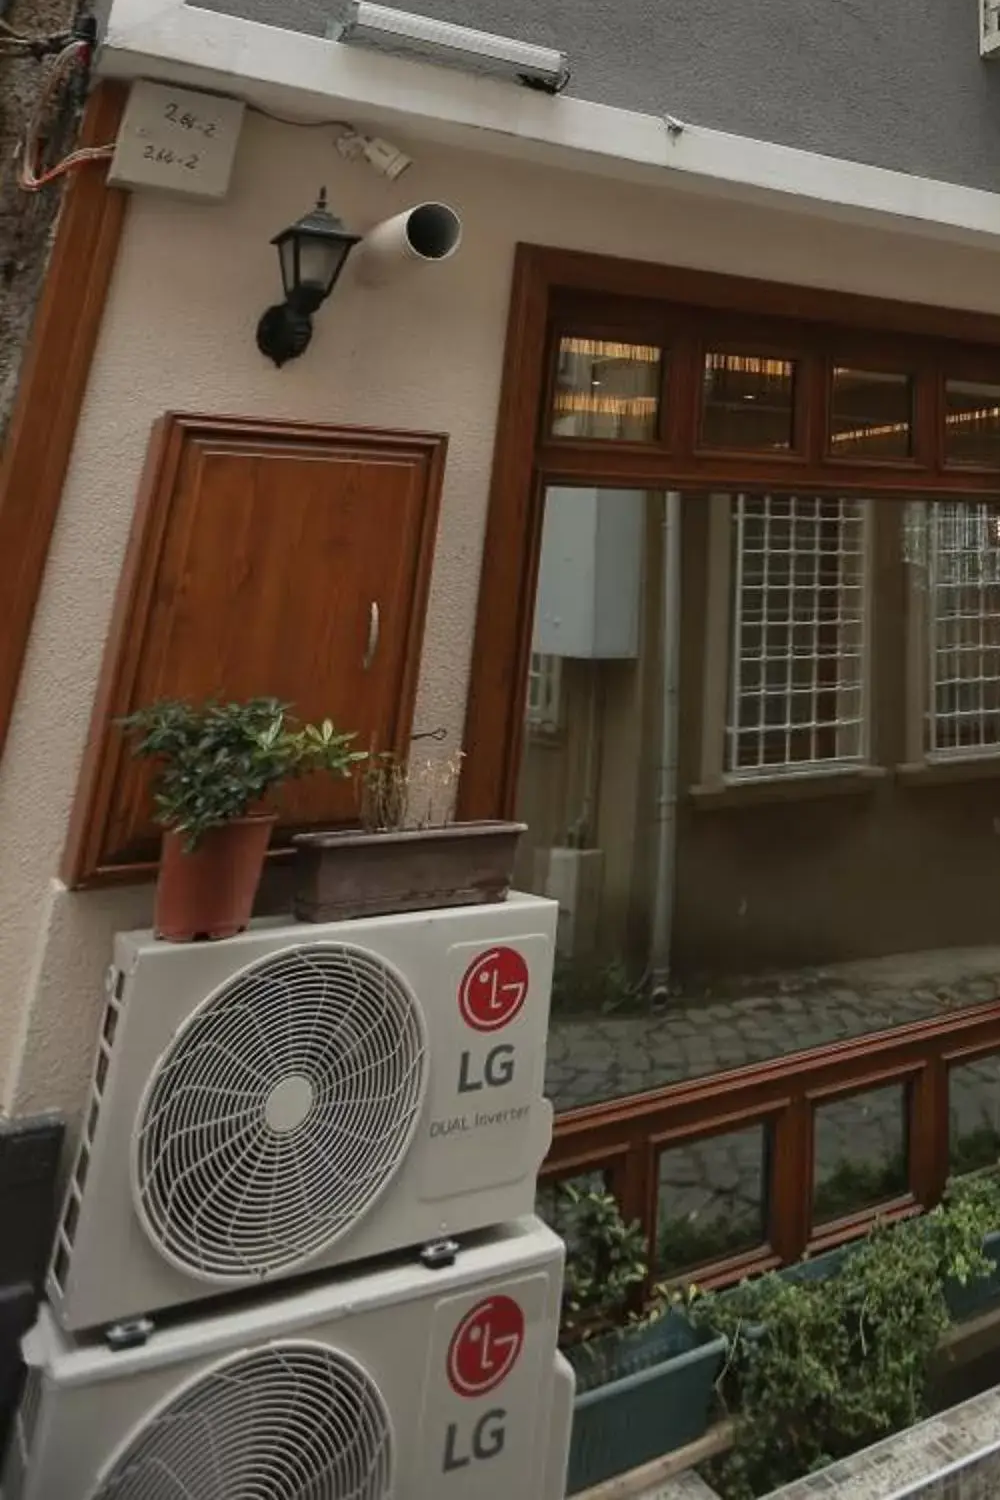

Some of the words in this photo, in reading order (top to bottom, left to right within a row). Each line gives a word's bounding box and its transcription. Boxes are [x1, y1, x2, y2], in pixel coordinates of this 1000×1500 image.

[457, 1043, 515, 1094] LG
[429, 1117, 471, 1139] DUAL
[474, 1104, 531, 1128] Inverter
[441, 1407, 508, 1474] LG
